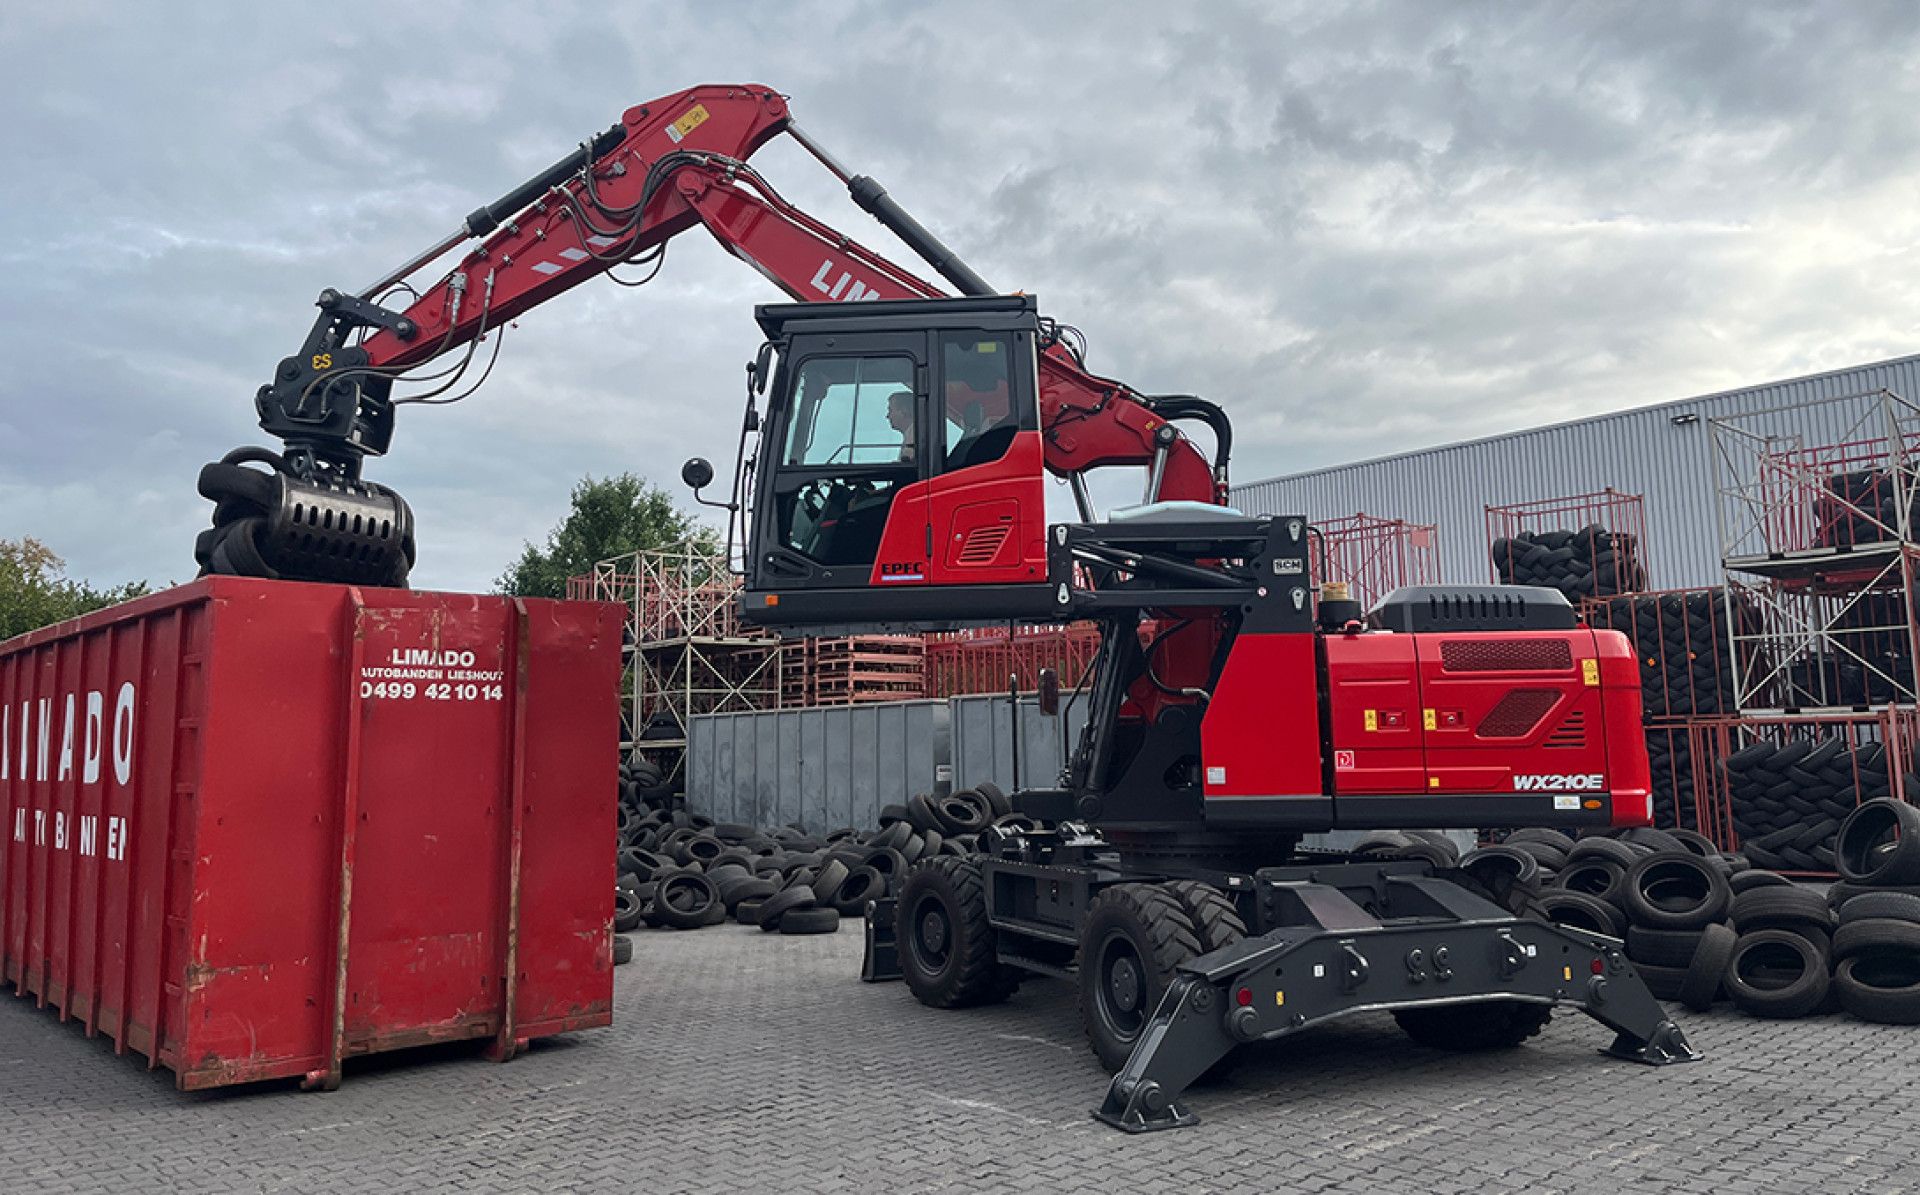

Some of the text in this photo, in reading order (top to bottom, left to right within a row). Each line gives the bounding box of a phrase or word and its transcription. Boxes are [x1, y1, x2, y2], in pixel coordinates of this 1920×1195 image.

[392, 648, 475, 667] LIMADO
[360, 681, 416, 699] 0499
[1513, 774, 1604, 790] WX210E
